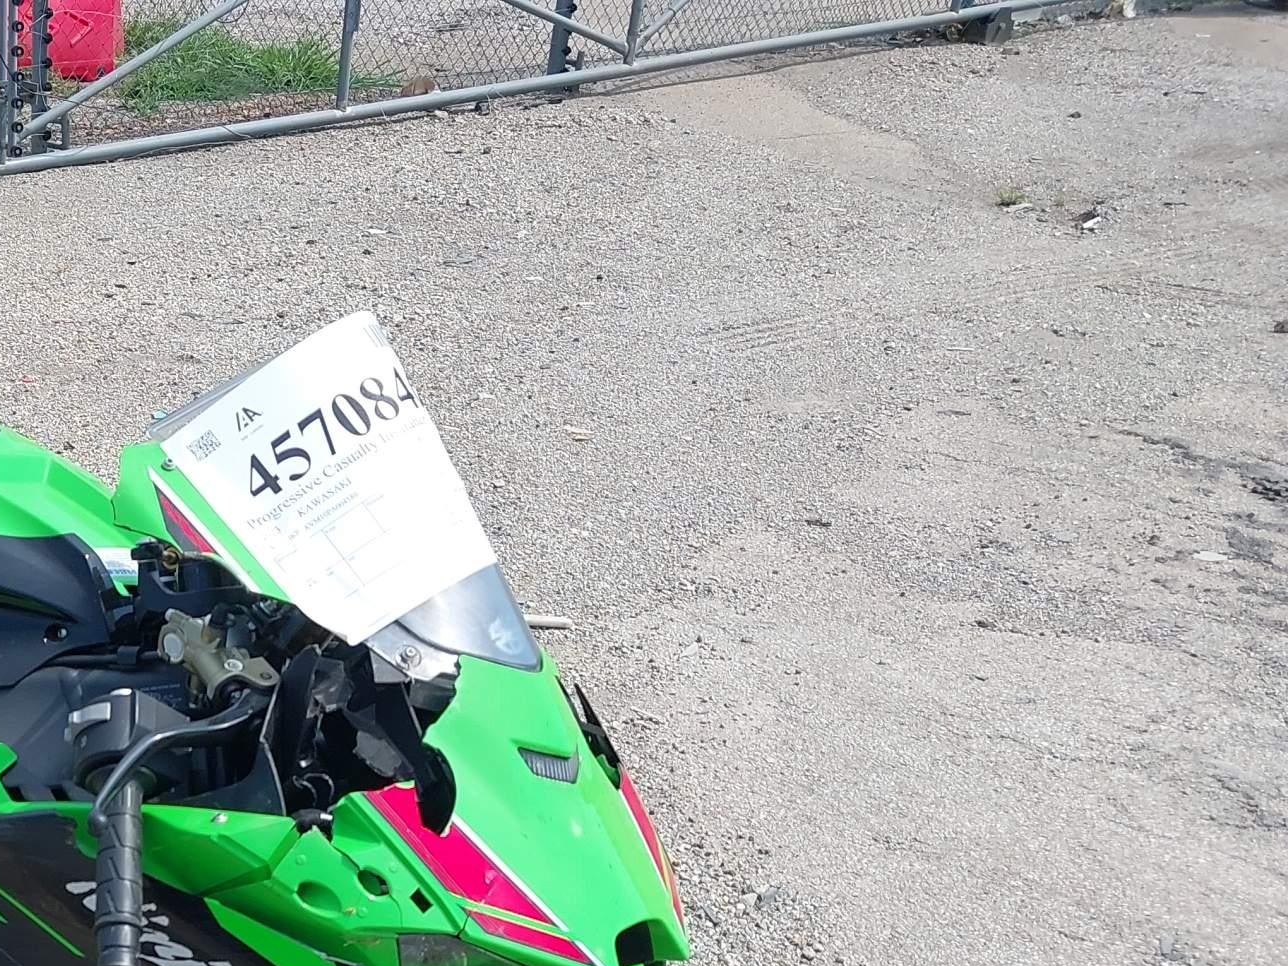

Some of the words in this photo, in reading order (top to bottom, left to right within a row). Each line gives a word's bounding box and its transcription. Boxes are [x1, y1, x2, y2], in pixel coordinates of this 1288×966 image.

[247, 477, 322, 530] Progressive
[322, 441, 378, 479] Casualty
[296, 477, 353, 518] KAWASAKI
